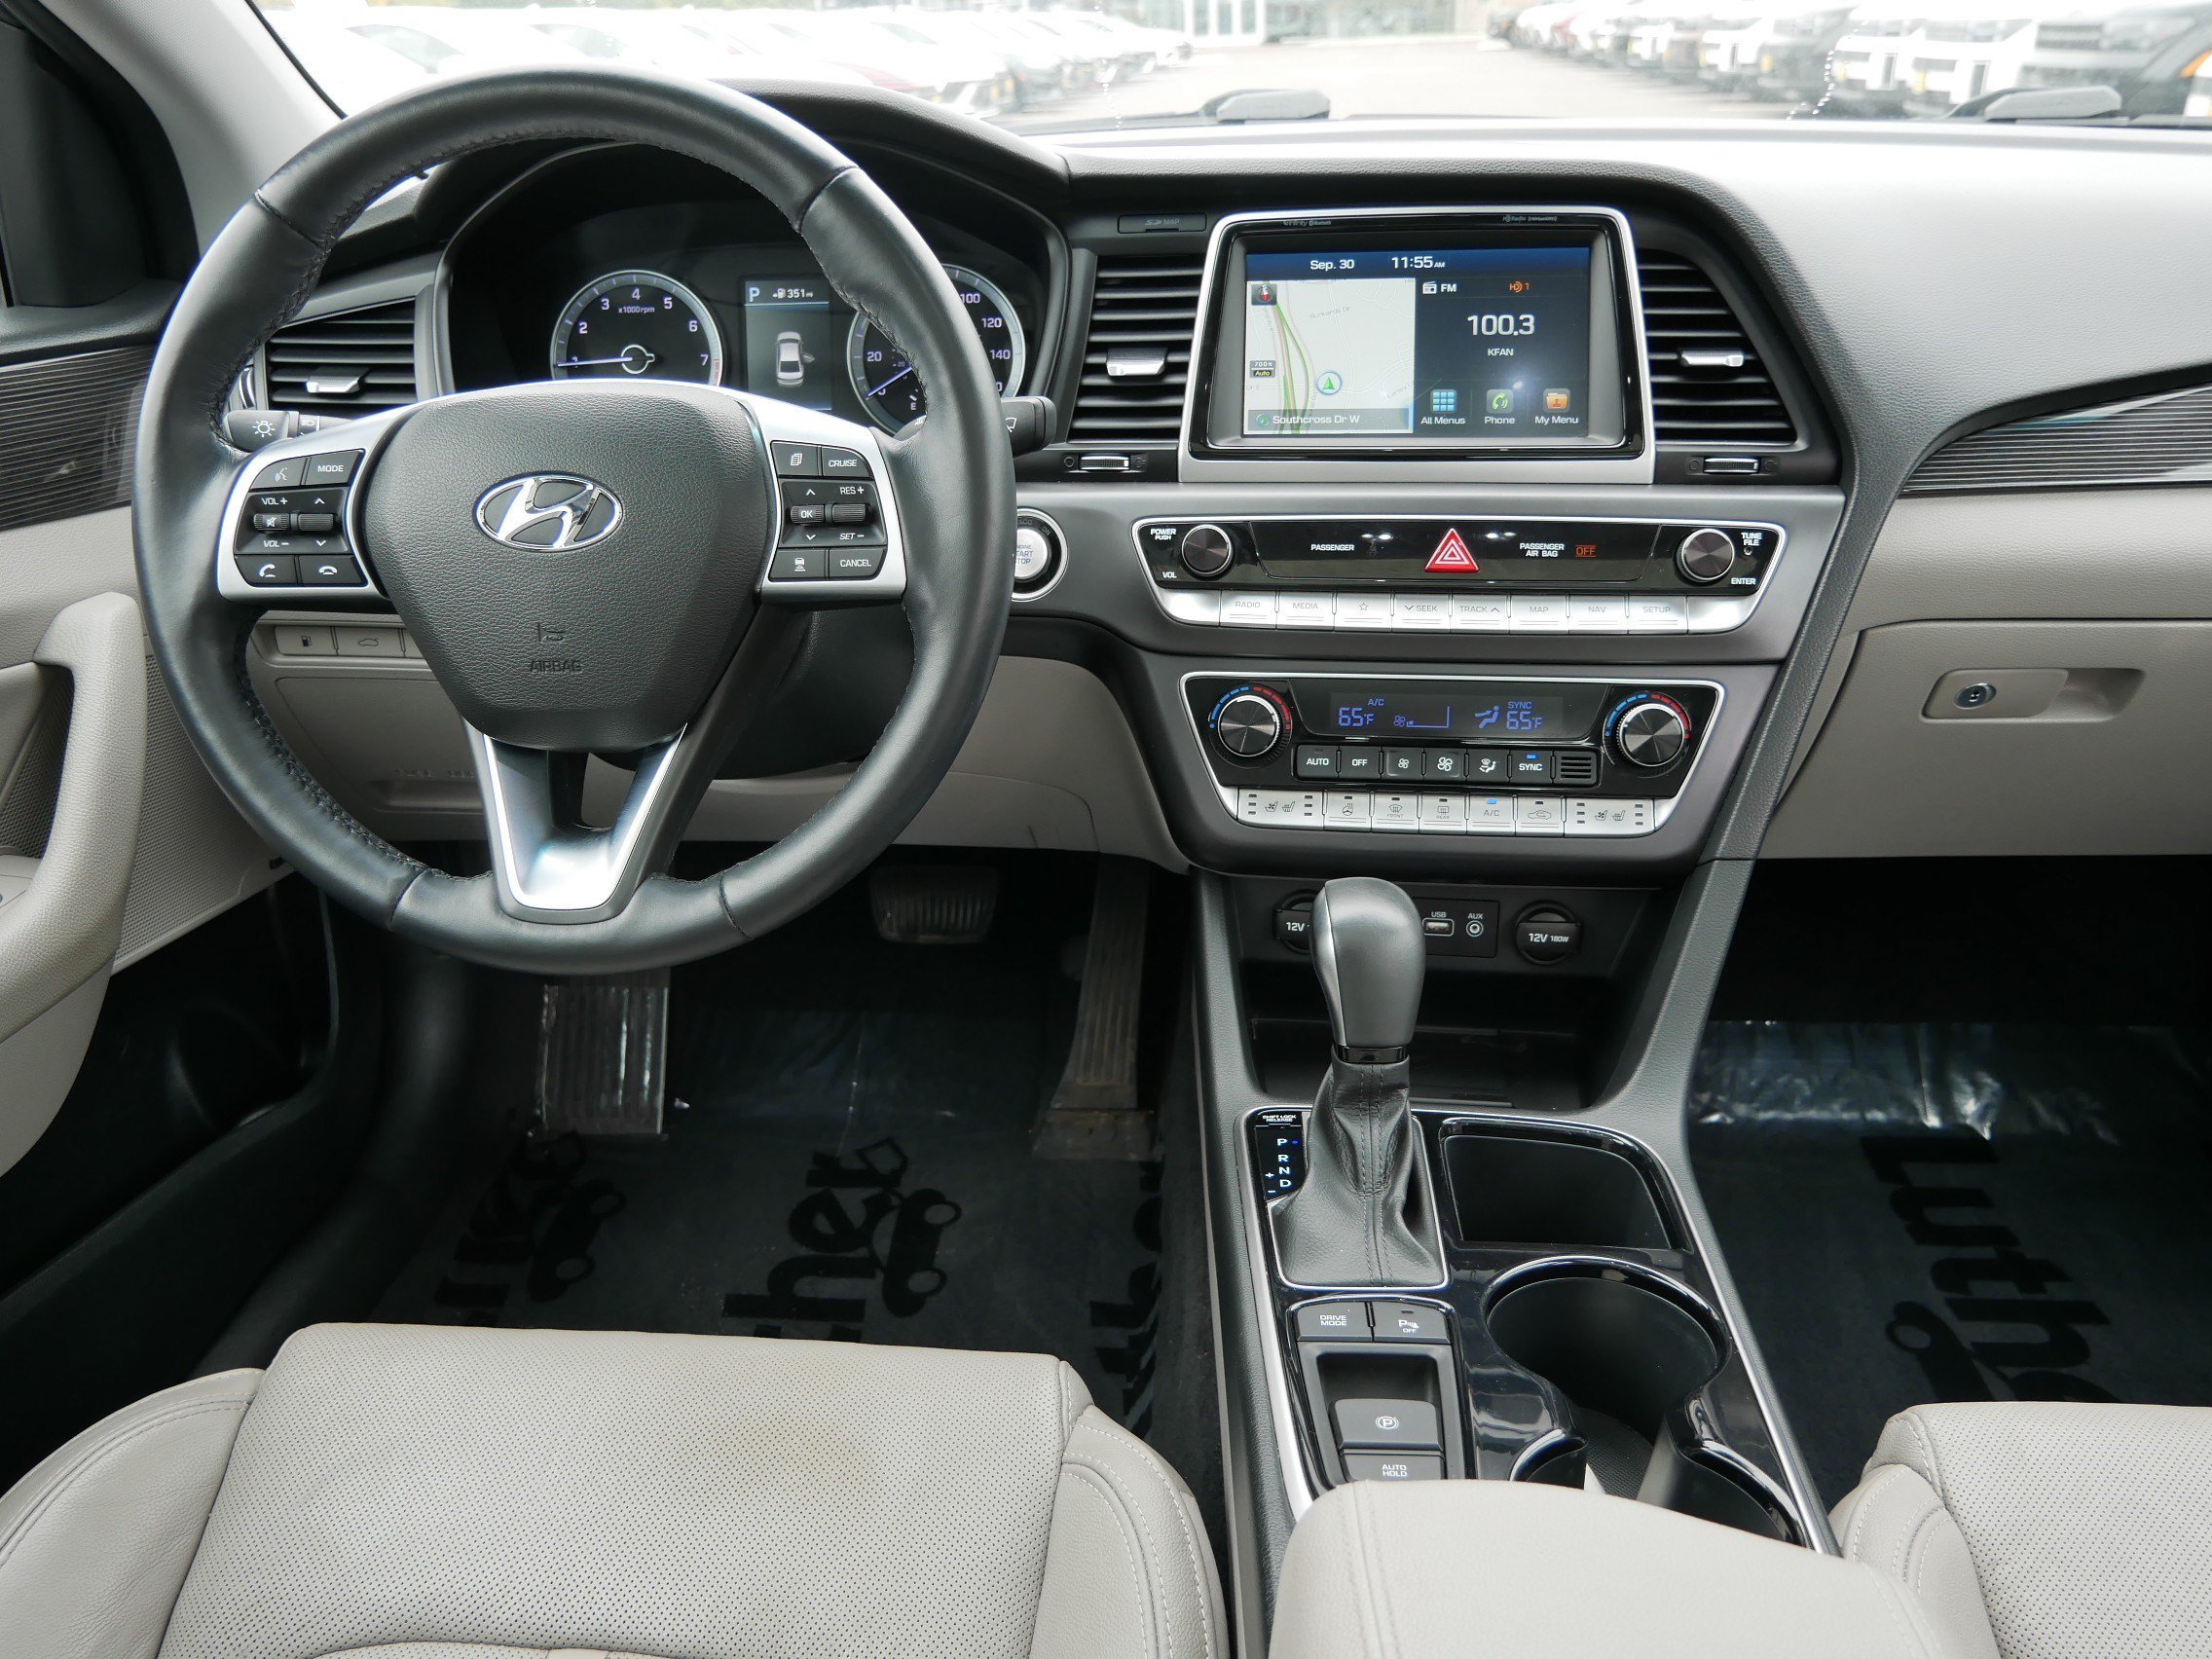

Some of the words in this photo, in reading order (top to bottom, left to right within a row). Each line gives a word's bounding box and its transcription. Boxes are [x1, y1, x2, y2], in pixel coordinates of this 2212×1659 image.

[1309, 260, 1337, 272] Sep.
[1340, 259, 1355, 270] 30
[1391, 256, 1434, 269] 11:55
[1441, 283, 1457, 292] FM
[632, 288, 641, 300] 4
[749, 286, 760, 303] P
[787, 288, 805, 299] 351
[960, 293, 981, 304] 100
[601, 298, 610, 311] 3
[663, 297, 673, 310] 5
[578, 321, 588, 334] 2
[688, 320, 698, 332] 6
[981, 317, 1003, 328] 120
[1467, 314, 1535, 336] 100.3
[866, 351, 882, 362] 20
[989, 350, 1011, 360] 140
[1487, 348, 1514, 356] KFAN
[700, 353, 709, 366] 7
[1272, 415, 1332, 424] Southcross
[1334, 415, 1347, 424] Dr
[1349, 415, 1360, 424] W
[1484, 416, 1516, 424] Phone
[1534, 416, 1550, 425] My
[1551, 416, 1579, 424] Menu
[1041, 527, 1051, 536] ON
[1519, 542, 1565, 551] PASSENGER
[1575, 546, 1596, 557] OFF
[1541, 549, 1558, 558] BAG
[1529, 606, 1549, 614] MAP
[1588, 606, 1606, 614] NAV
[1642, 606, 1671, 614] SETUP
[530, 660, 583, 673] AIRBAG
[1368, 698, 1384, 707] A/C
[1306, 757, 1330, 766] AUTO
[1351, 758, 1368, 767] OFF
[1519, 762, 1542, 771] SYNC
[1285, 921, 1305, 932] 12V
[1529, 933, 1548, 943] 12V
[1276, 1138, 1288, 1147] P
[1277, 1154, 1289, 1162] R
[1278, 1166, 1290, 1175] N
[1279, 1179, 1292, 1188] D
[1861, 1136, 2122, 1402] Luth
